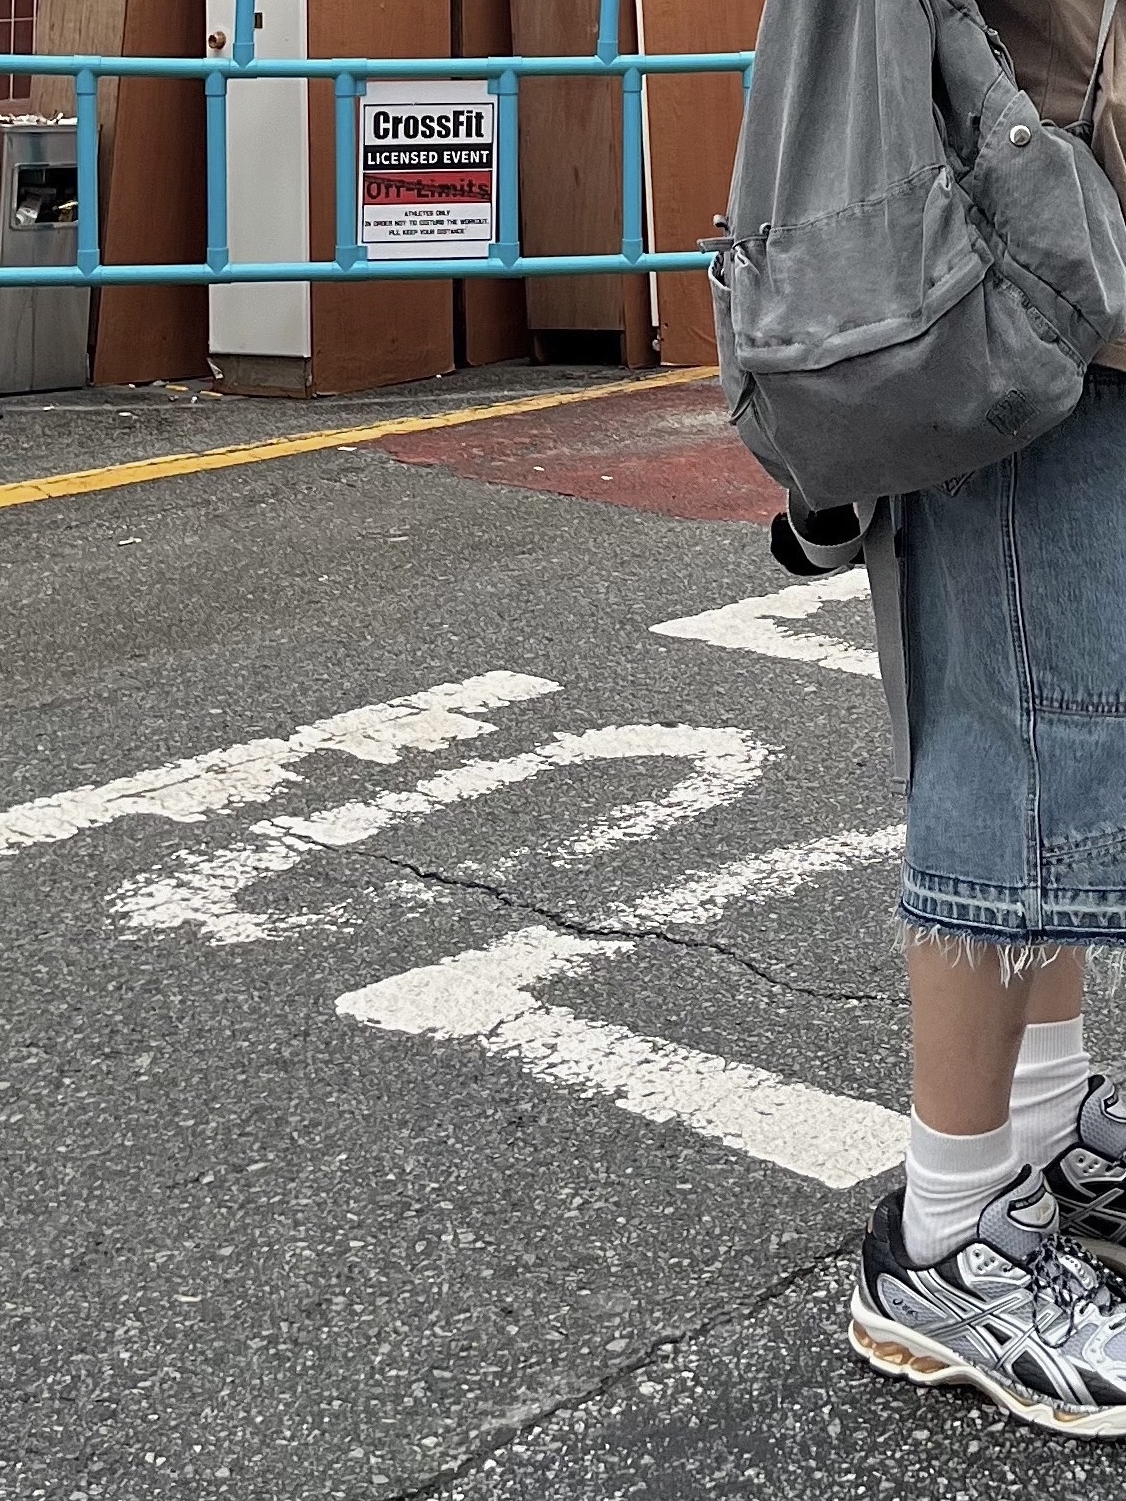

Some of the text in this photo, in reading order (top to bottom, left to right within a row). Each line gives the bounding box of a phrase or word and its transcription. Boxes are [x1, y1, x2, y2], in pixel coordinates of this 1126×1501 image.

[373, 109, 485, 140] CrossFit
[367, 150, 490, 165] LICENSED EVENT
[366, 177, 491, 200] Off-Limits
